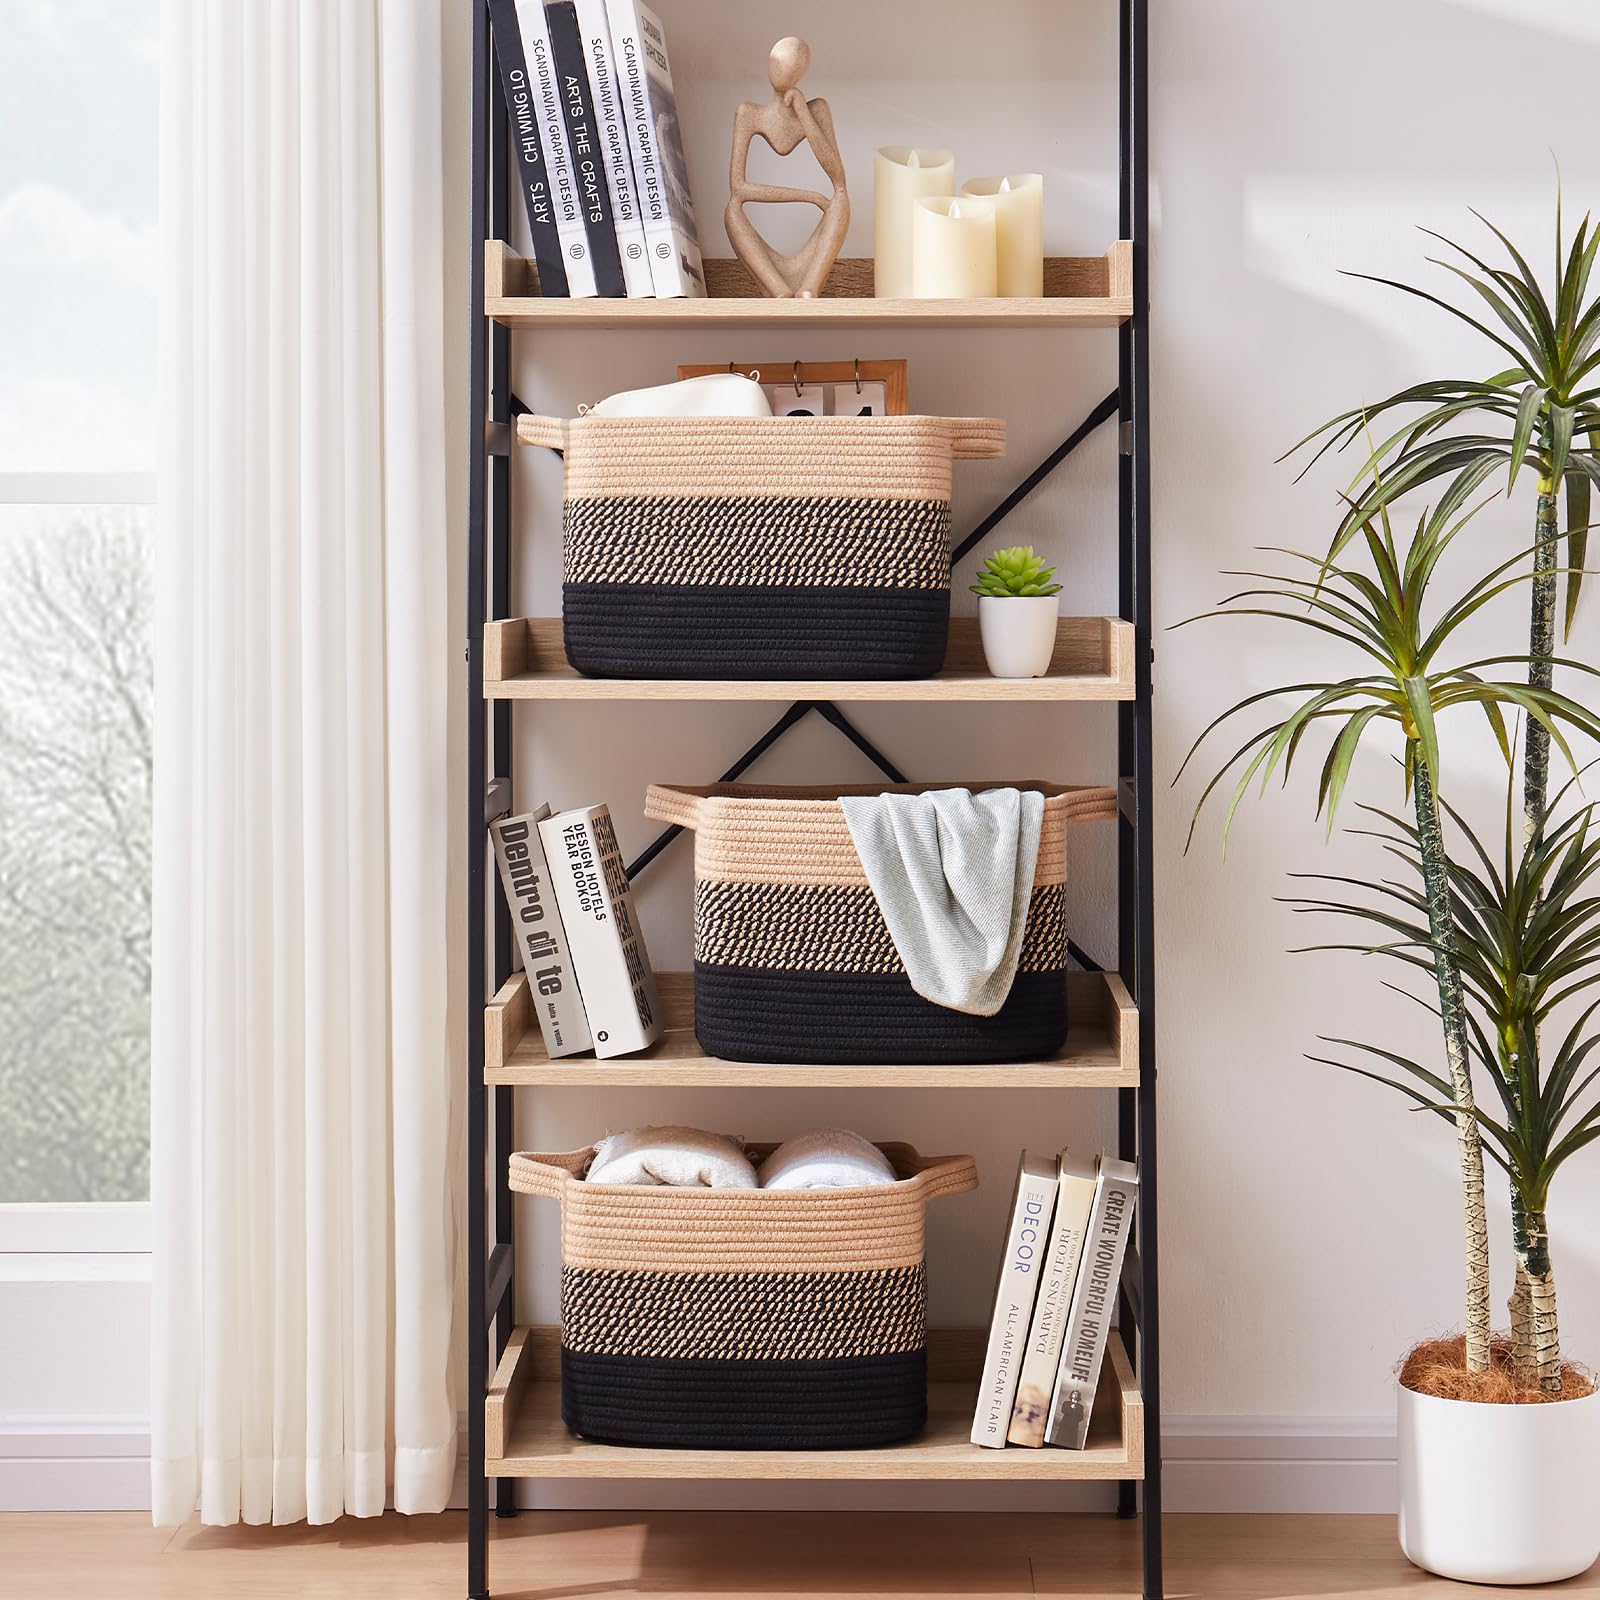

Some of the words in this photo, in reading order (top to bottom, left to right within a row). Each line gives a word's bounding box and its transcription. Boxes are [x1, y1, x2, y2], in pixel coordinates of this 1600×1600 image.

[510, 69, 525, 89] LO
[565, 75, 583, 117] ARTS
[514, 93, 533, 134] WING
[533, 39, 557, 121] SCANDINAVIAV
[549, 125, 567, 176] GRAPHIC
[559, 178, 575, 220] DESIGN
[574, 122, 591, 155] THE
[592, 39, 616, 121] SCANDINAVIAV
[607, 125, 625, 175] GRAPHIC
[616, 178, 632, 220] DESIGN
[623, 37, 646, 121] SCANDINAVIAV
[637, 124, 655, 174] GRAPHIC
[646, 178, 662, 220] DESIGN
[521, 136, 538, 162] CHI
[530, 182, 550, 223] ARTS
[581, 160, 602, 222] CRAFTS
[562, 825, 579, 858] YEAR
[500, 820, 545, 923] Dentro
[574, 823, 594, 868] DESIGN
[586, 873, 607, 921] HOTELS
[526, 931, 559, 959] di
[536, 965, 562, 996] te
[1014, 1201, 1042, 1273] DECOR
[1101, 1190, 1127, 1236] CREATE
[1036, 1279, 1060, 1353] DARWINS
[1053, 1228, 1071, 1275] TEORI
[1084, 1239, 1117, 1316] WONDERFUL
[995, 1303, 1019, 1395] ALL-AMERICAN
[1071, 1319, 1100, 1383] HOMELIFE
[987, 1399, 1002, 1433] FLAIR
